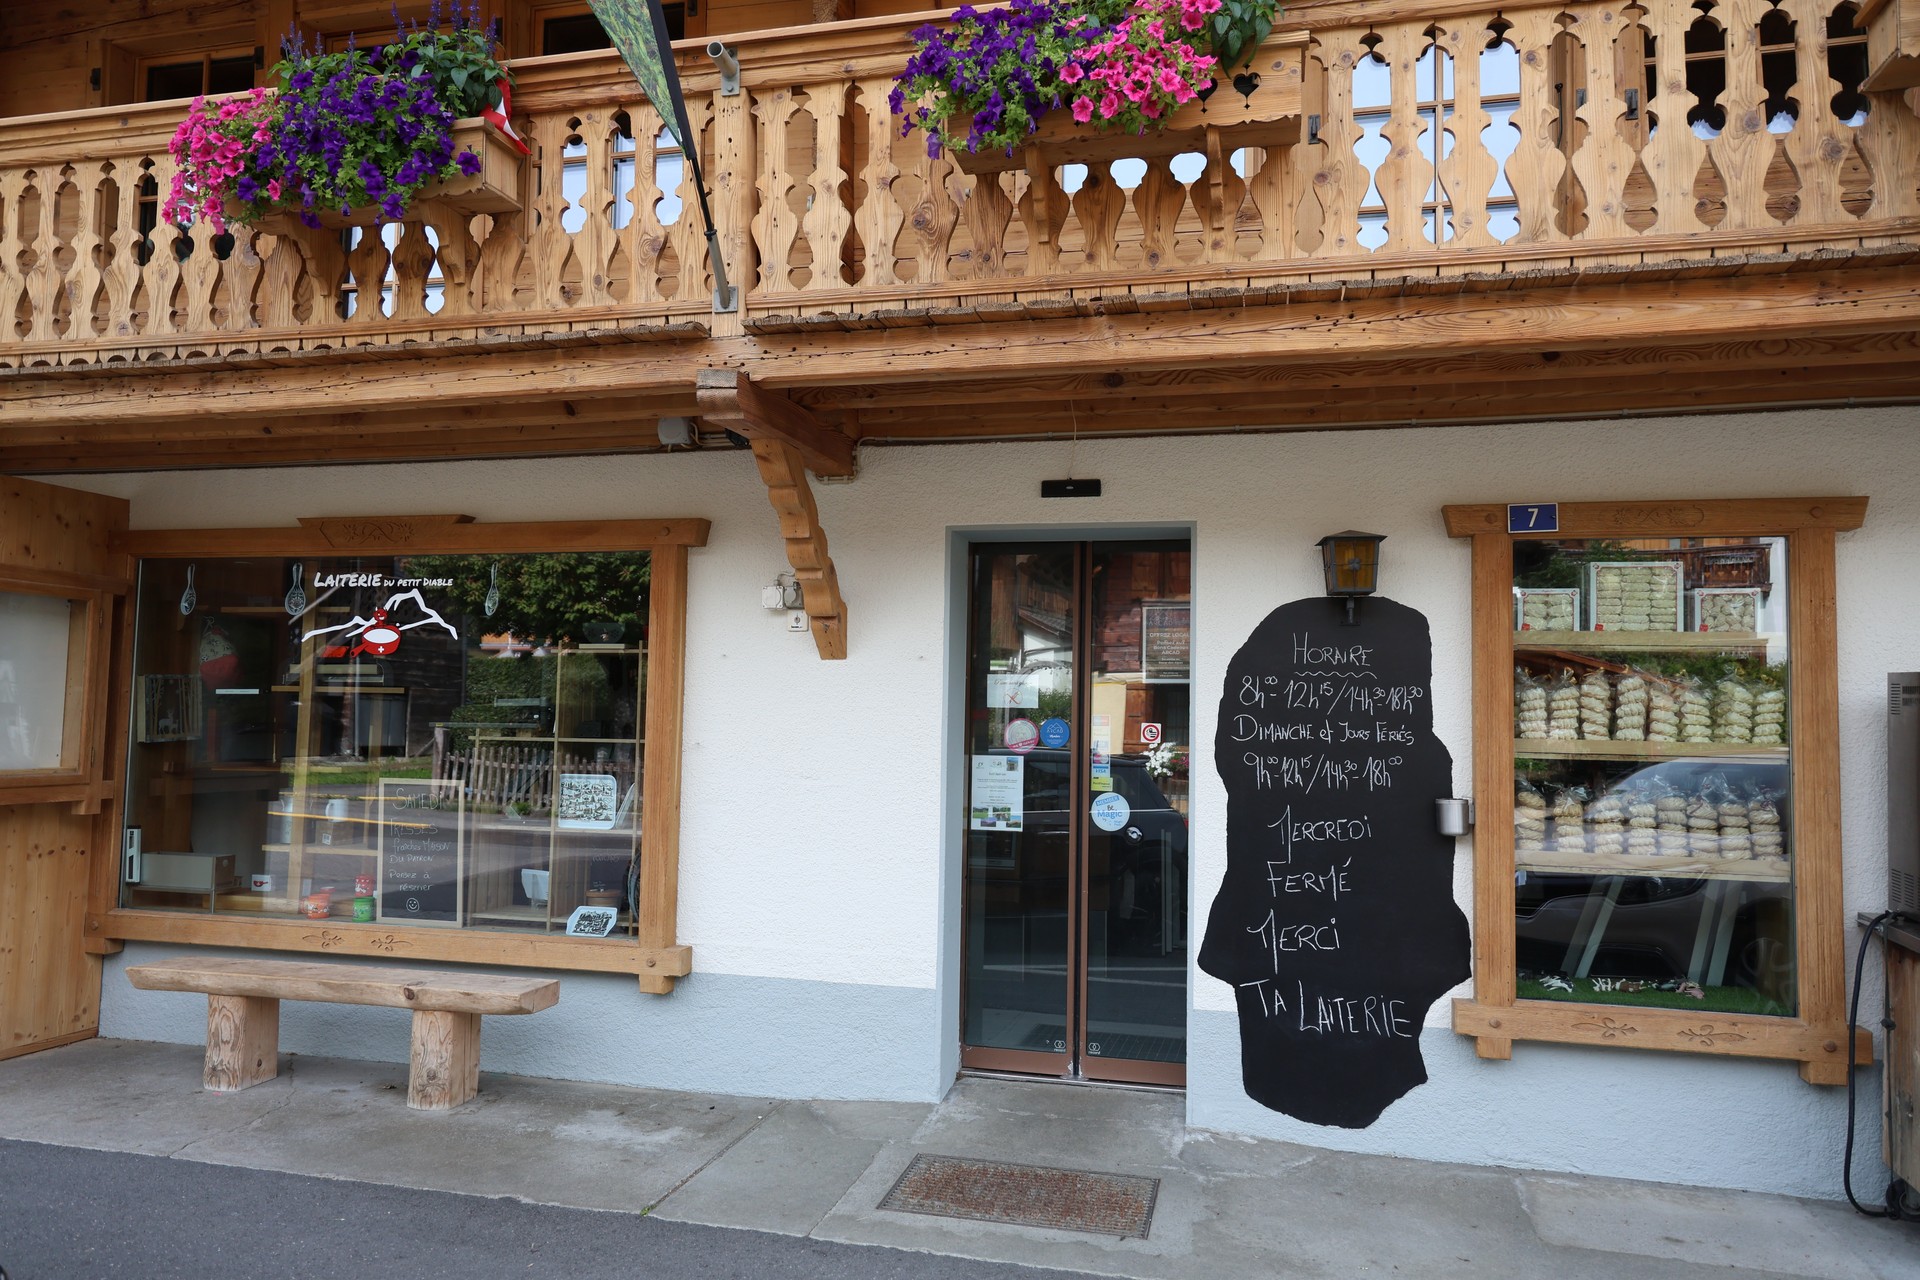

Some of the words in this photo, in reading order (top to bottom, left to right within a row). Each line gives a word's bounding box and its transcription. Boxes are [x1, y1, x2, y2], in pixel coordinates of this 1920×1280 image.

[1527, 507, 1539, 528] 7
[313, 571, 382, 588] LAITERIE
[383, 578, 395, 587] DU
[397, 578, 422, 587] PETIT
[423, 577, 453, 587] DIABLE
[1097, 809, 1123, 819] Magic
[1267, 856, 1352, 901] FERMÉ
[1240, 978, 1287, 1018] TA
